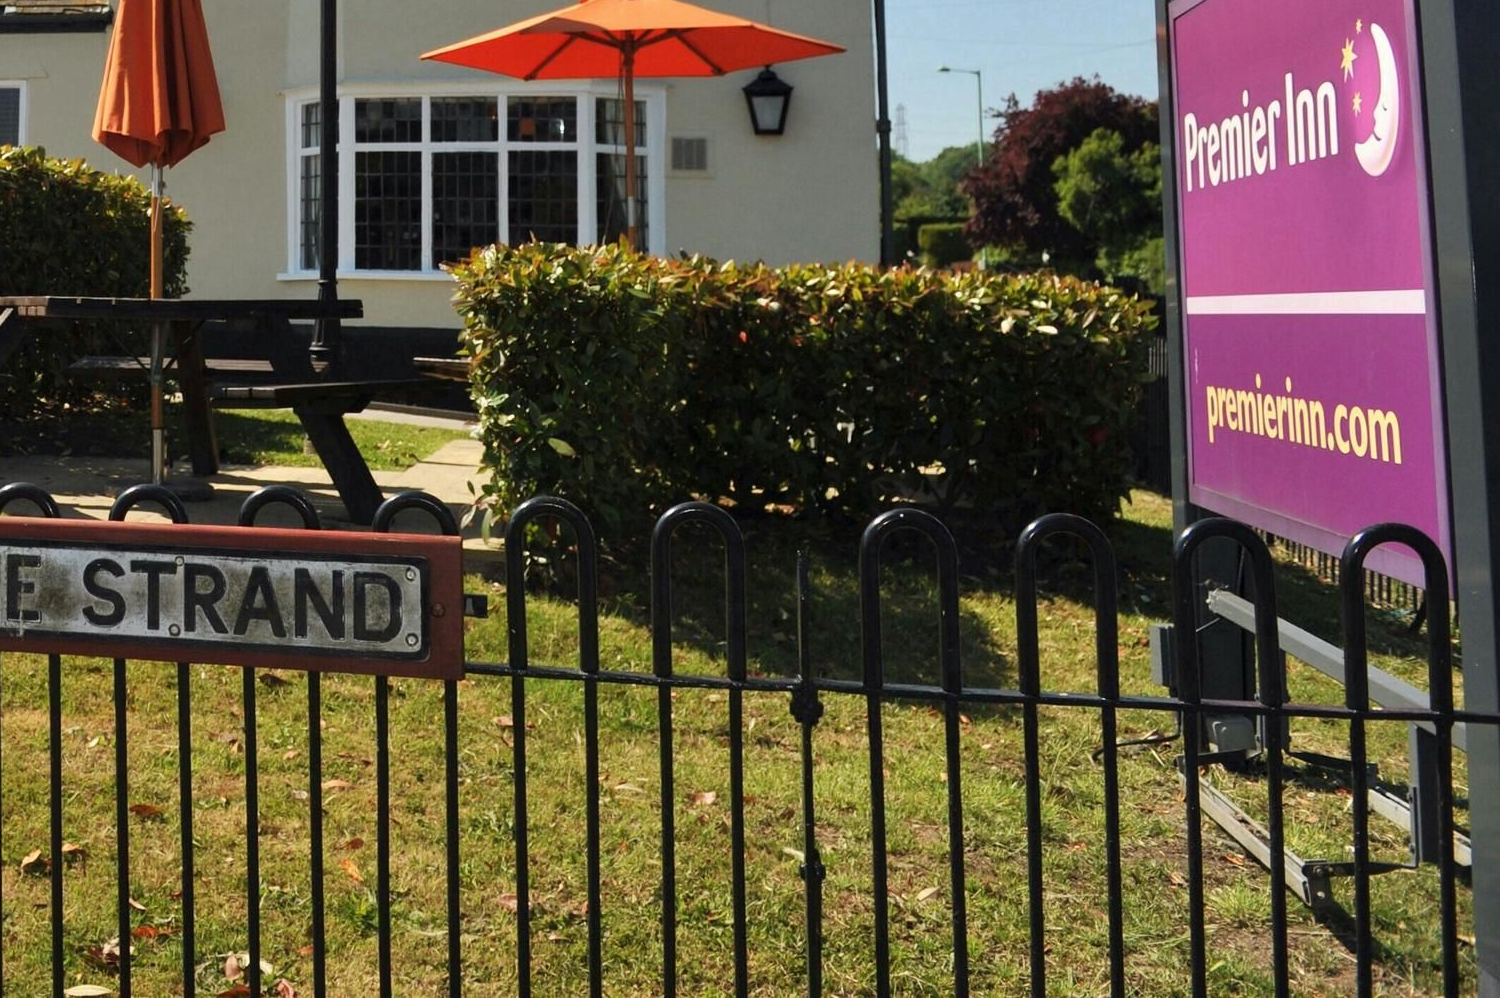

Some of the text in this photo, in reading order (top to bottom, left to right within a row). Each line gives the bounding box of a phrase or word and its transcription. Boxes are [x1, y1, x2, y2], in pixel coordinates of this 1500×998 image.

[1184, 72, 1339, 192] Premier Inn
[1206, 373, 1402, 464] premierinn.com
[81, 558, 401, 642] STRAND
